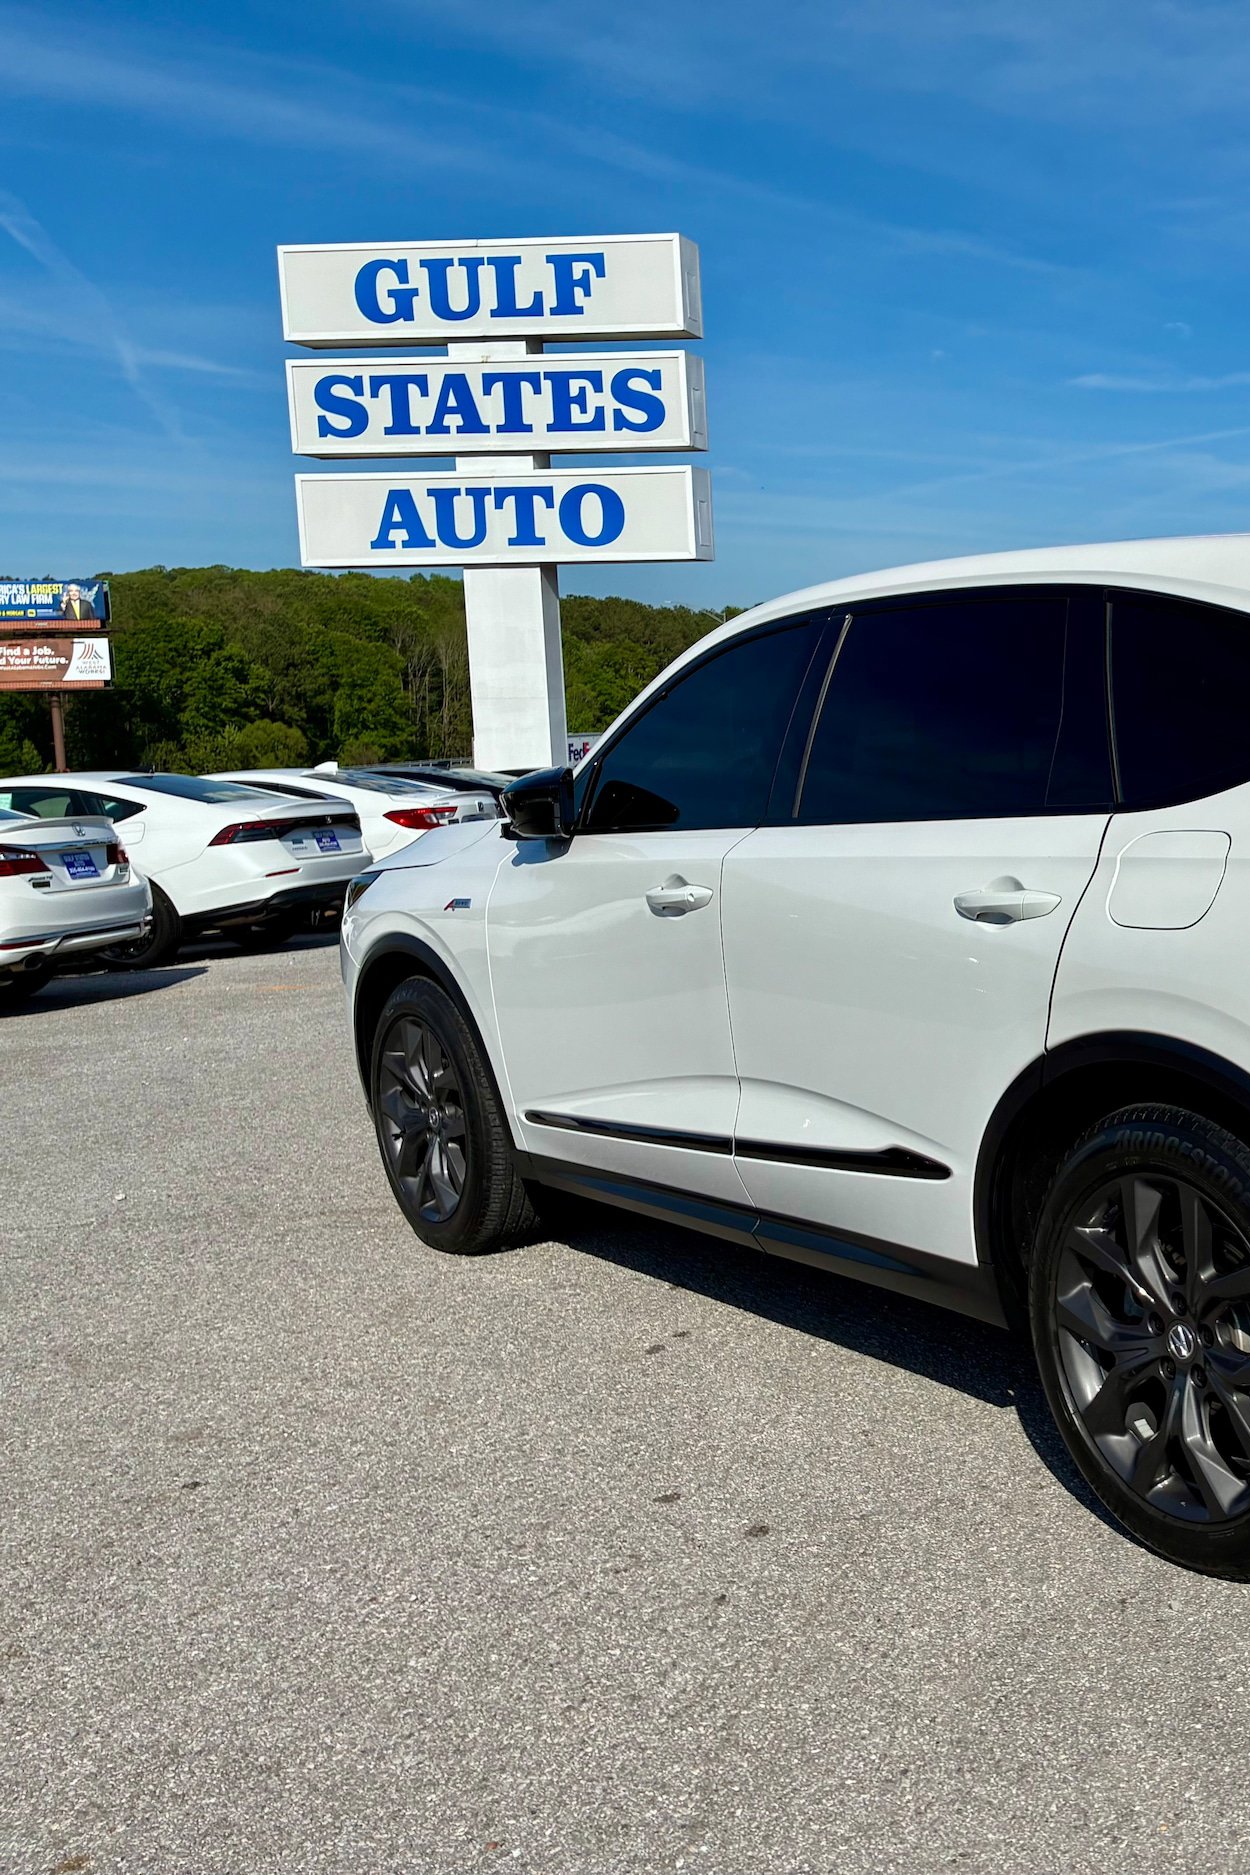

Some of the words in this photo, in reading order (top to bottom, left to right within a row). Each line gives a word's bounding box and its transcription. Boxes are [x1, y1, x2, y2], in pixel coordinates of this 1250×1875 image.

[354, 252, 606, 324] GULF
[313, 368, 666, 438] STATES
[370, 483, 626, 550] AUTO
[26, 583, 63, 594] LARGEST
[11, 594, 30, 605] LAW
[31, 593, 53, 605] FIRM
[23, 648, 30, 656] a
[32, 645, 55, 656] Job.
[7, 656, 32, 665] Your
[33, 656, 69, 665] Future.
